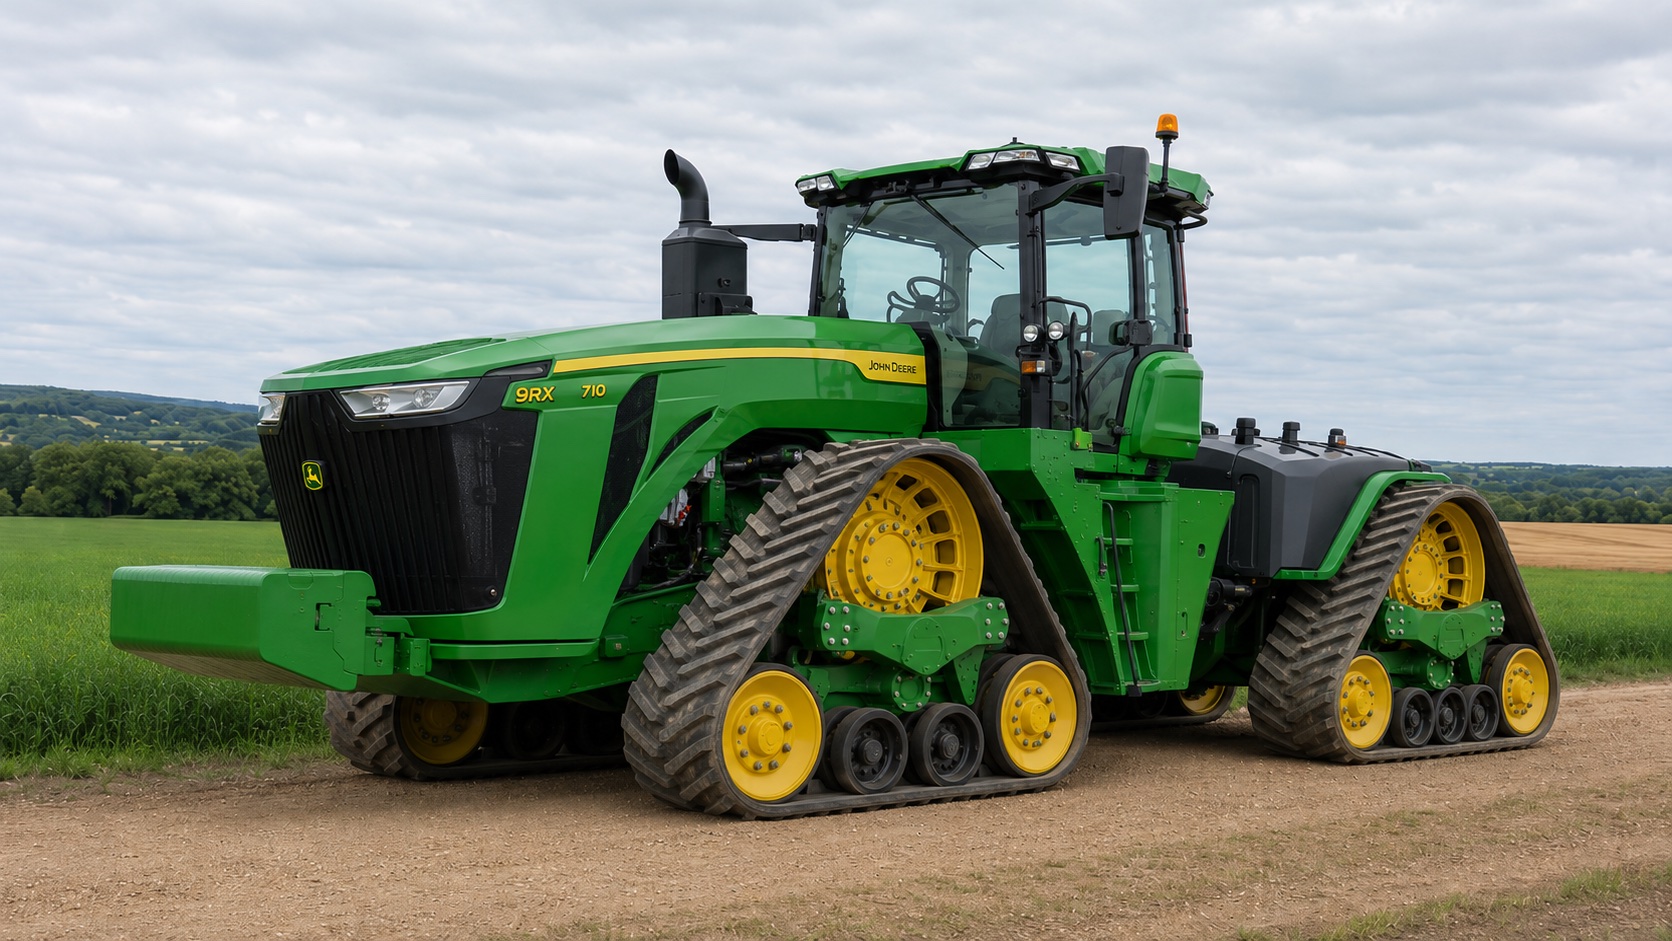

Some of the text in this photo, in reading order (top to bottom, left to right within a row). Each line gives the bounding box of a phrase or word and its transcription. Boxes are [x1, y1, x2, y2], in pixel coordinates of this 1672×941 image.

[868, 360, 917, 374] JOHN DEERE
[515, 383, 606, 403] 9RX 710
